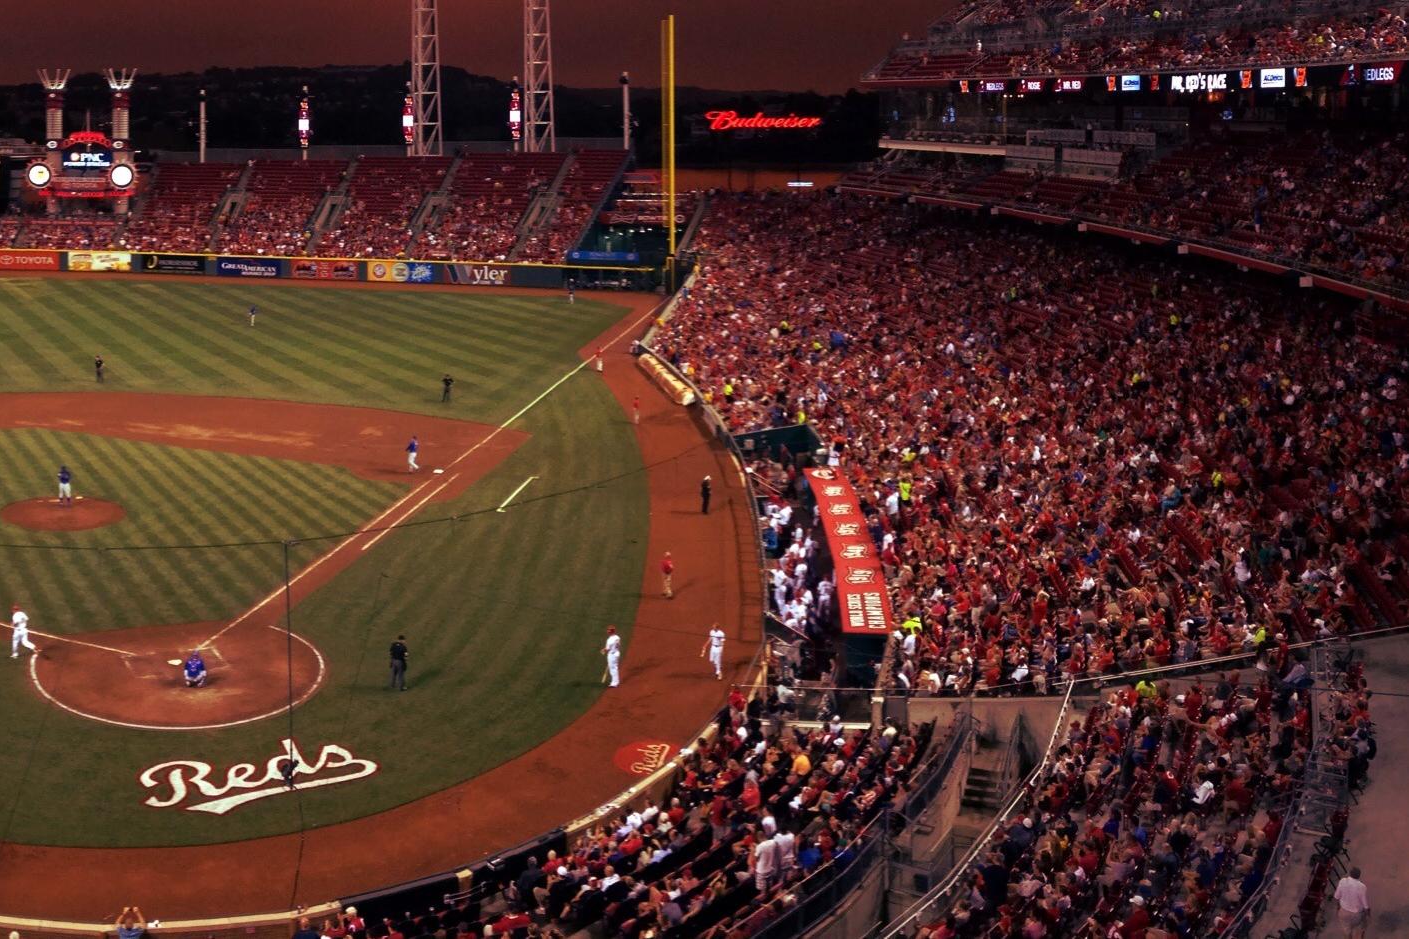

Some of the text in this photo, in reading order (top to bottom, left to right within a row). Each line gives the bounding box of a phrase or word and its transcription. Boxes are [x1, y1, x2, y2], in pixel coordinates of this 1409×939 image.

[705, 110, 822, 130] Budweiser
[80, 153, 104, 162] PNC
[15, 256, 55, 265] TOYOTA
[863, 592, 886, 629] CHAMPIONS
[631, 744, 670, 775] Reds
[140, 738, 378, 815] Reds
